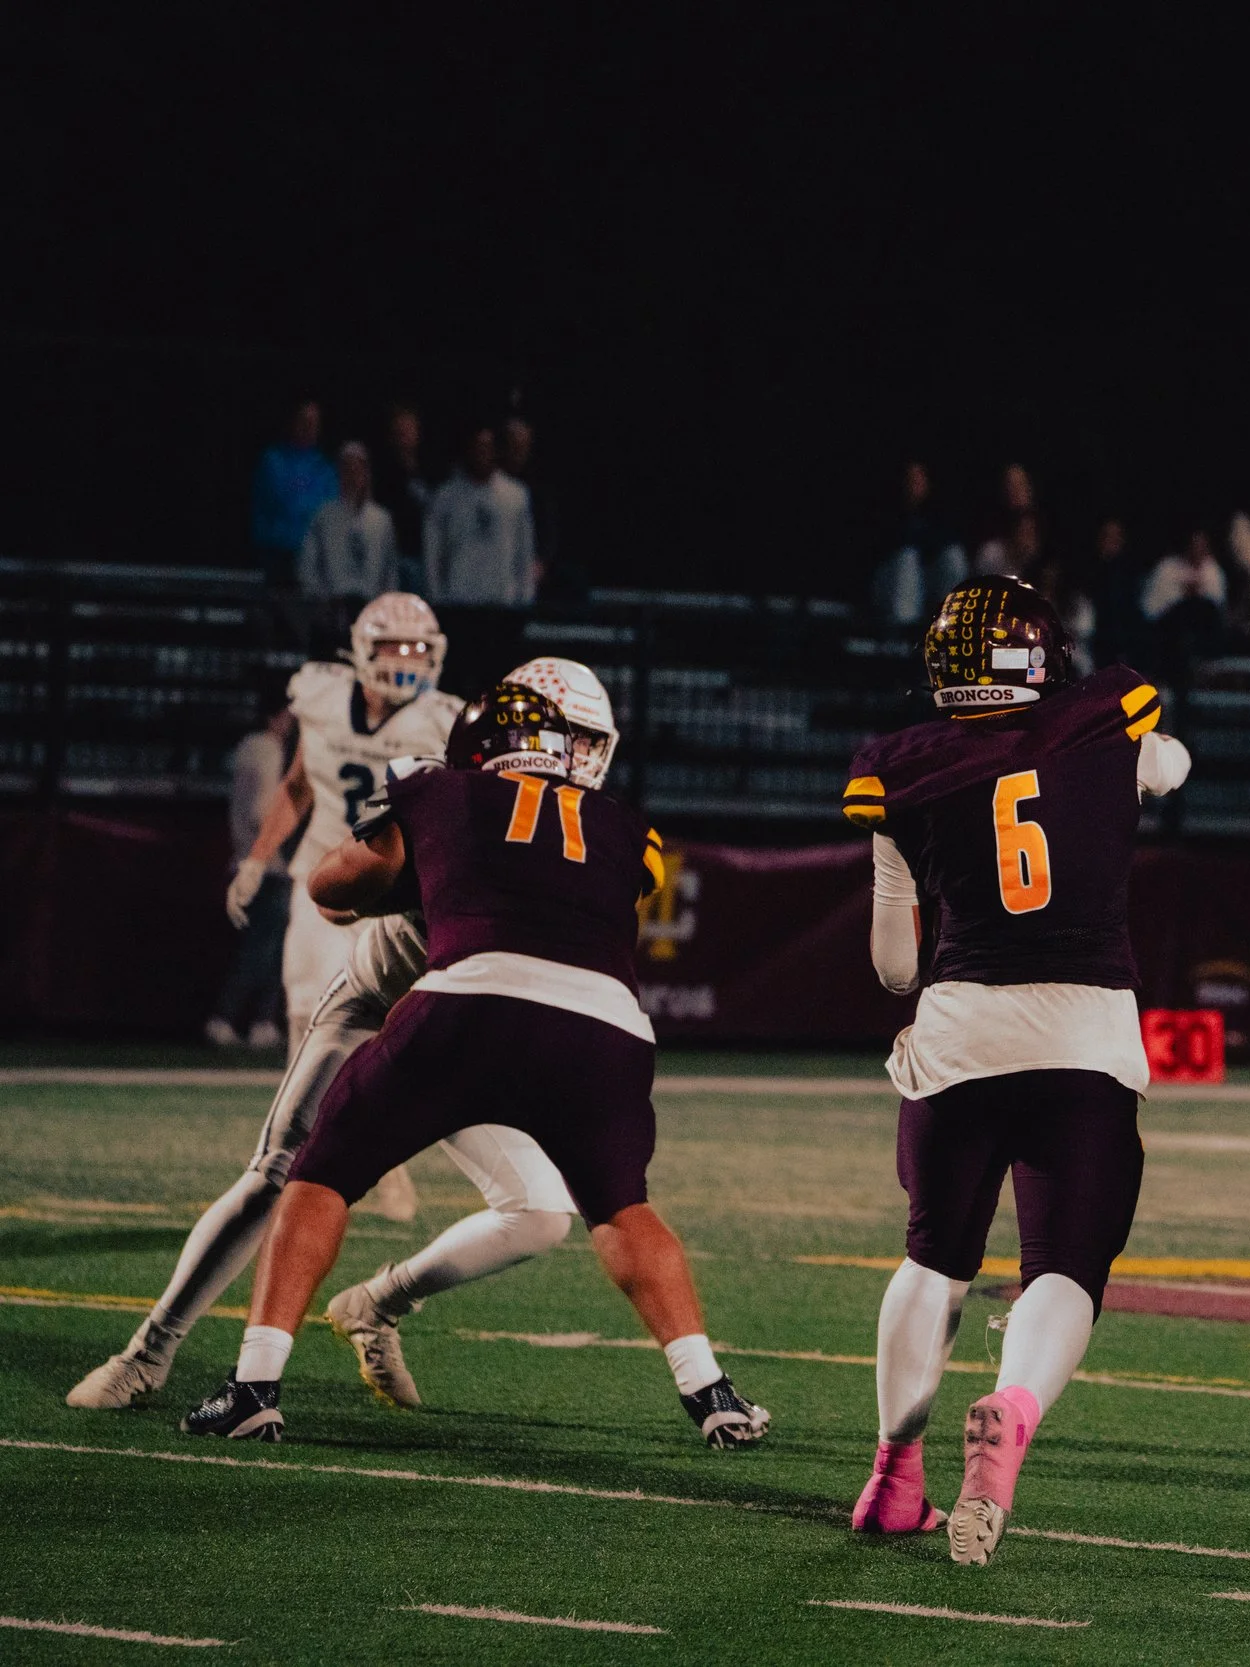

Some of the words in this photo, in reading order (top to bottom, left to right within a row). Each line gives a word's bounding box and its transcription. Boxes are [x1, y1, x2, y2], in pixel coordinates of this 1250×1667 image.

[940, 689, 1014, 703] BRONCOS
[497, 769, 586, 863] 71
[992, 768, 1052, 915] 6
